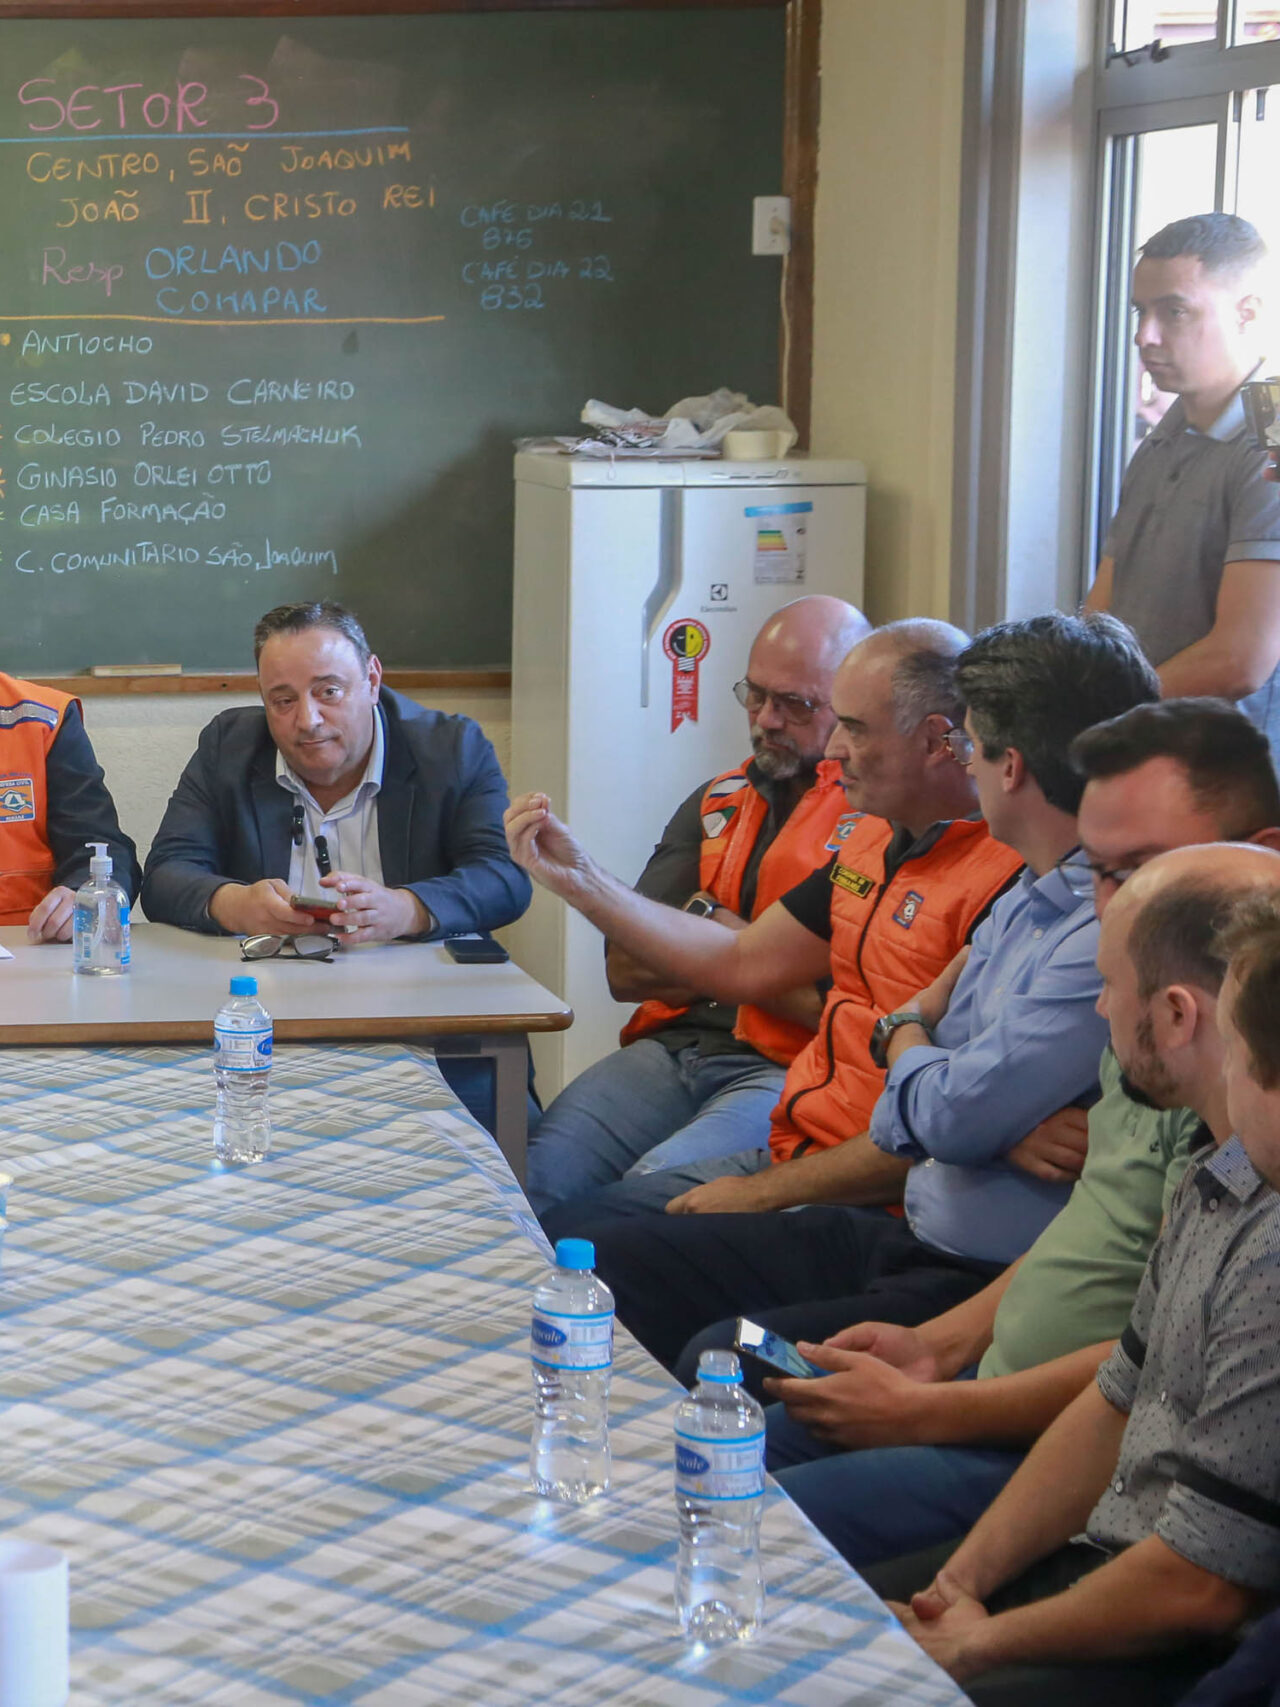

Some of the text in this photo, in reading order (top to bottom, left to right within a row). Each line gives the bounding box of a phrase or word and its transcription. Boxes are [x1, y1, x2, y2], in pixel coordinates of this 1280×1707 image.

[18, 75, 279, 133] SETOR 3
[280, 143, 412, 173] JOAQUIM
[244, 191, 357, 222] CRISTO
[383, 185, 436, 211] REI
[527, 202, 562, 221] DIA
[42, 241, 321, 296] Resp ORLANDO
[527, 260, 570, 279] DIA
[481, 282, 546, 310] 832
[22, 330, 153, 356] ANTIOCHO
[10, 381, 112, 407] ESCOLA
[123, 380, 209, 405] DAVID
[226, 378, 355, 406] CARNEIRO
[15, 422, 121, 447] COLEGIO
[140, 421, 205, 448] PEDRO
[17, 462, 117, 491] GINASIO
[133, 459, 198, 486] ORLEI
[208, 460, 272, 485] OTTO
[20, 503, 80, 526] CASA
[101, 491, 226, 526] FORMAÇÃO
[51, 541, 199, 573] COMUNITARIO
